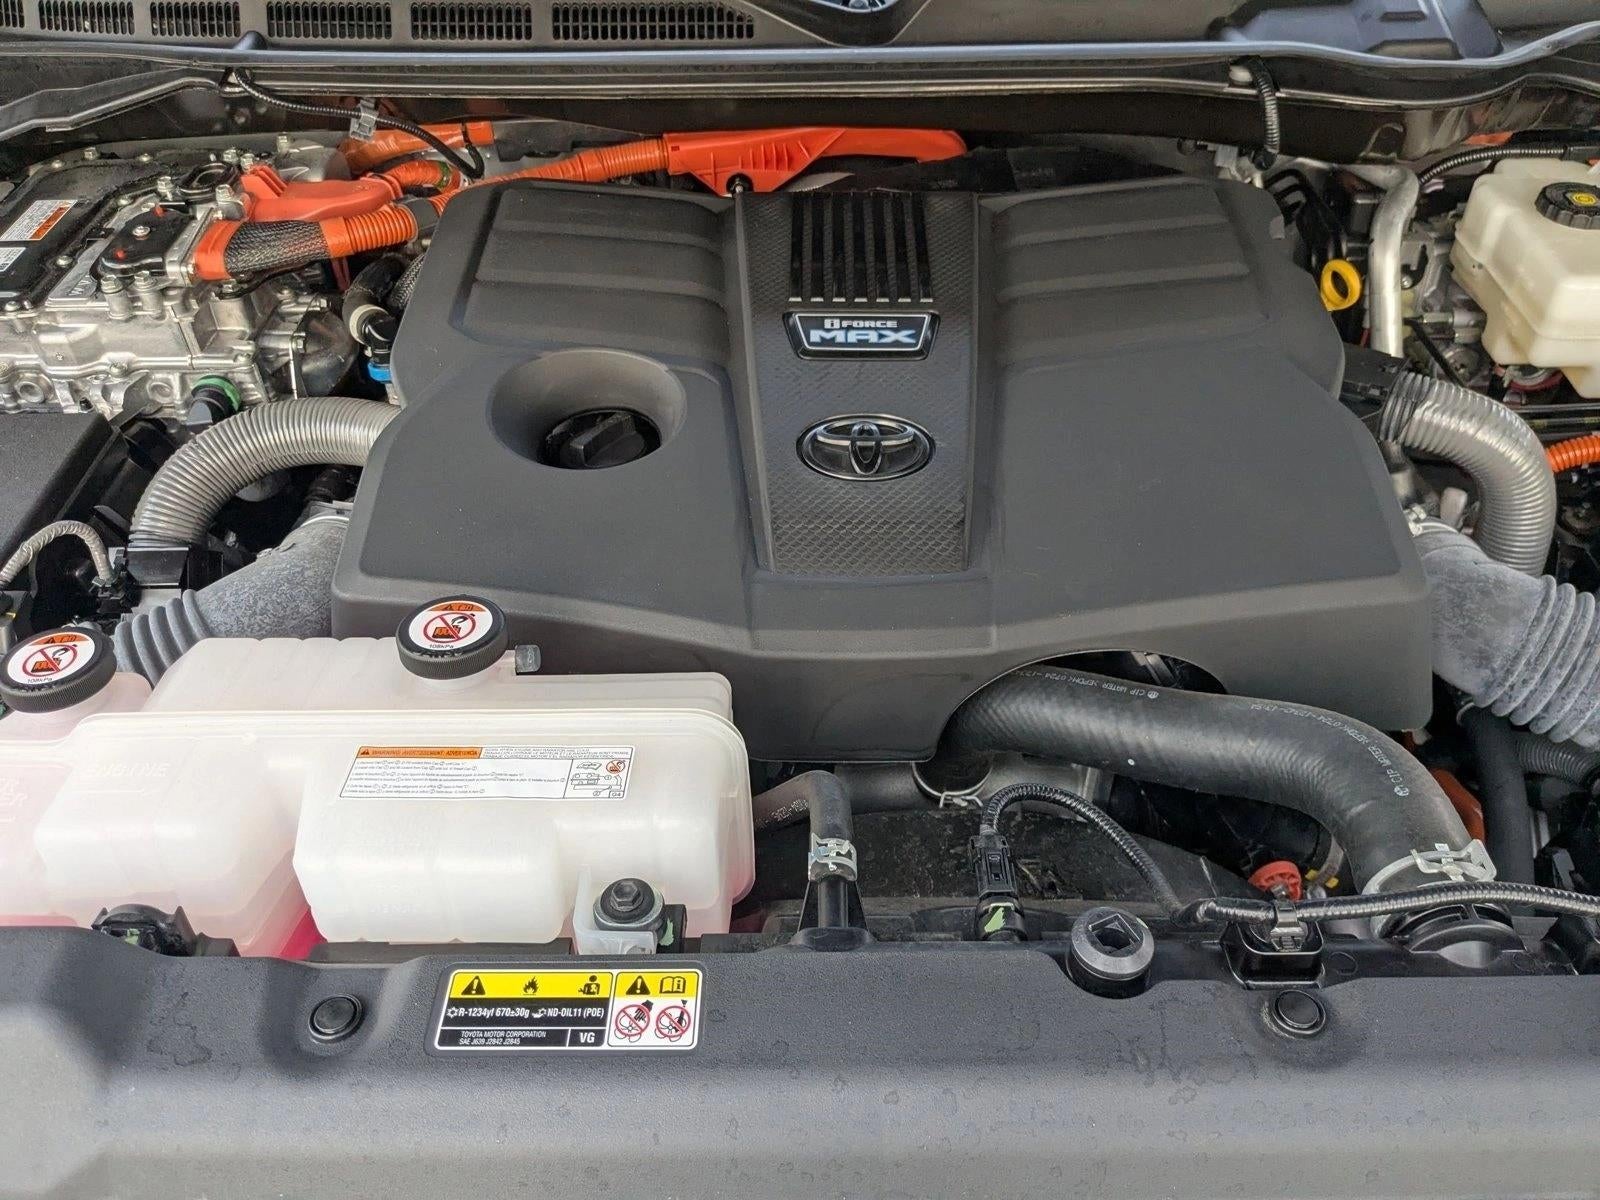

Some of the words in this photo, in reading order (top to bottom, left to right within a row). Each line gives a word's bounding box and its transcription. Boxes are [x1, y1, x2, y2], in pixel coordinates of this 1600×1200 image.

[809, 330, 917, 343] MAX
[459, 1008, 494, 1018] R-1234yf
[496, 1008, 530, 1019] 670±30g
[548, 1008, 582, 1016] ND-OIL11
[583, 1007, 605, 1019] (POE)
[580, 1033, 595, 1043] VG
